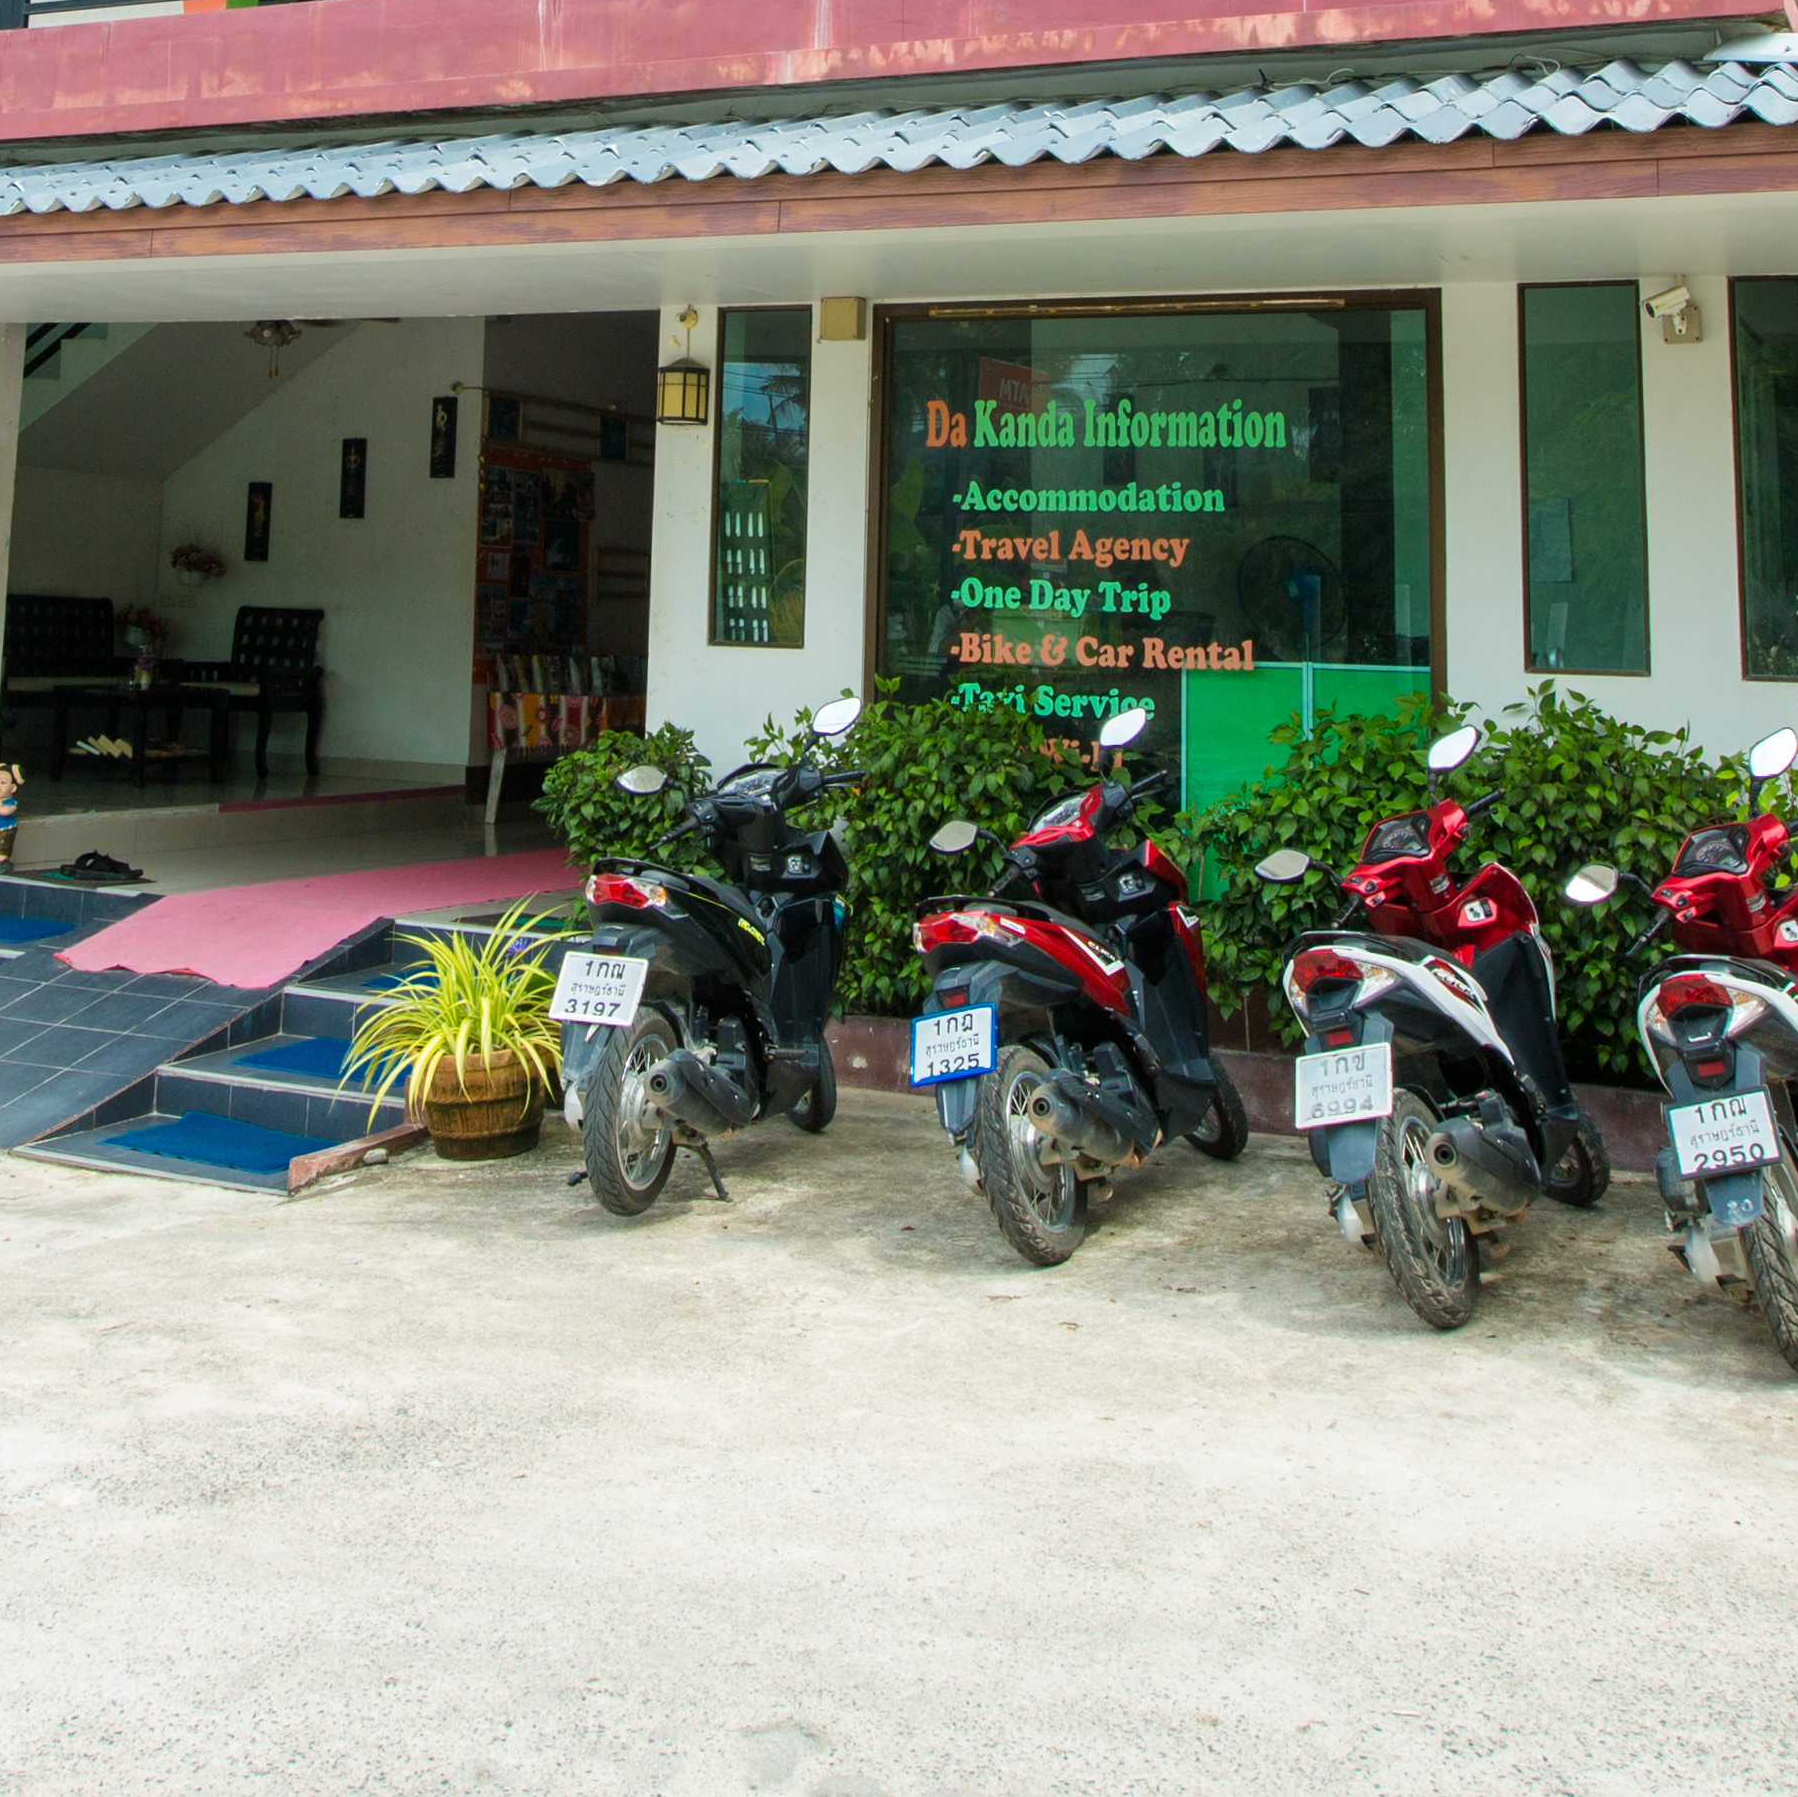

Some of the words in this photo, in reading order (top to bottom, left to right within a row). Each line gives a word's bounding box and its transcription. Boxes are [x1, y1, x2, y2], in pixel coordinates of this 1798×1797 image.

[925, 400, 968, 448] Da
[973, 399, 1076, 448] Kanda
[1083, 399, 1286, 449] Information
[1068, 530, 1190, 568] Agency
[1029, 580, 1091, 618] Day
[1098, 581, 1171, 620] Trip
[1041, 634, 1068, 666] &
[1076, 635, 1134, 669] Car
[1142, 636, 1256, 672] Rental
[1033, 684, 1156, 721] Service
[564, 998, 621, 1018] 3197
[926, 1052, 980, 1077] 1325
[1310, 1095, 1373, 1119] 6994
[1693, 1142, 1765, 1170] 2950
